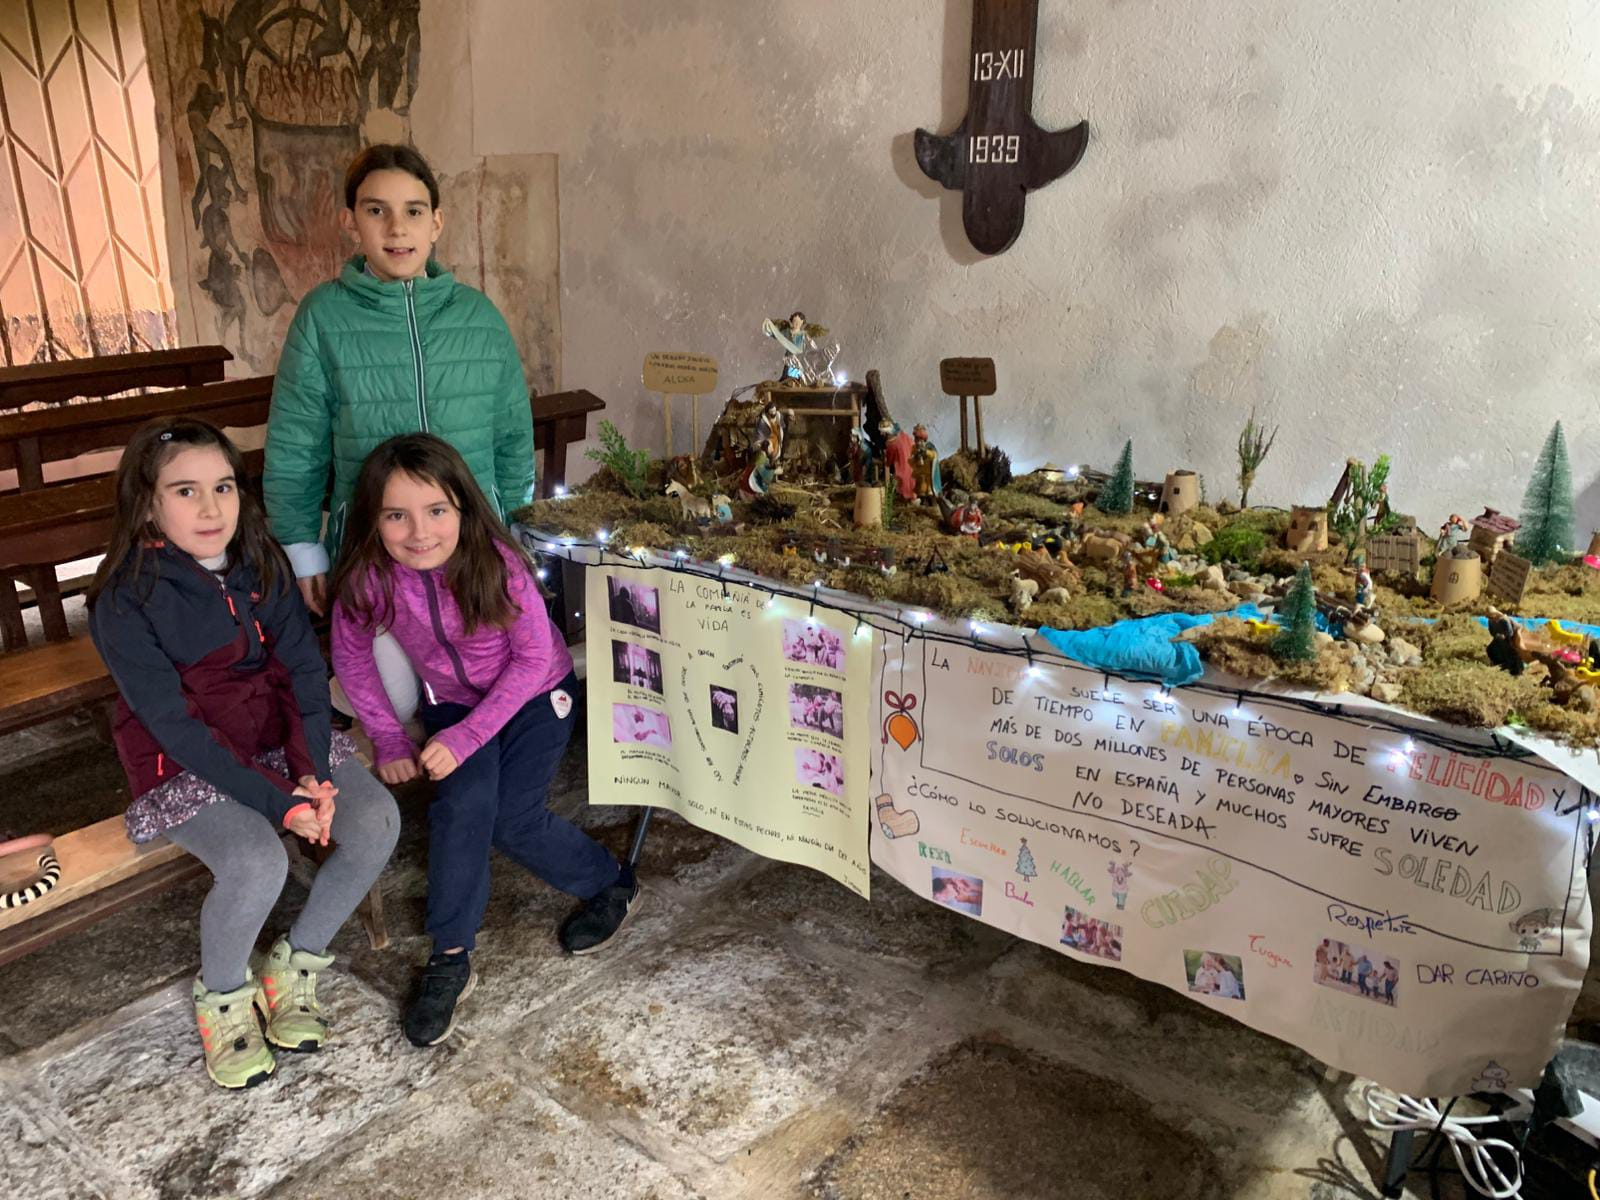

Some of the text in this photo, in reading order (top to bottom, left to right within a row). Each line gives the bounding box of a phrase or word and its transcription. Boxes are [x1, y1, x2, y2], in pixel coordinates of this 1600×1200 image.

[974, 49, 1024, 81] 13-XII
[969, 134, 1020, 163] 1939
[669, 577, 685, 594] LA
[685, 600, 696, 609] LA
[740, 609, 751, 620] ES
[931, 647, 950, 671] LA
[1069, 686, 1125, 705] SUELE
[1143, 698, 1177, 715] SER
[1192, 708, 1230, 729] UNA
[1247, 714, 1314, 748] ÉPOCA
[1333, 740, 1368, 766] DE
[1552, 788, 1566, 811] Y
[992, 686, 1014, 706] DE
[1034, 695, 1094, 723] TIEMPO
[1115, 714, 1145, 733] EN
[1362, 784, 1462, 821] EMBARGO
[990, 715, 1018, 735] MÁS
[1025, 724, 1042, 739] DE
[1055, 729, 1083, 747] DOS
[1180, 756, 1201, 777] DE
[1216, 768, 1297, 805] PERSONAS
[1307, 799, 1391, 835] MAYORES
[968, 801, 987, 816] LO
[1072, 790, 1104, 810] NO
[720, 811, 731, 822] EN
[986, 740, 1046, 773] SOLOS
[1075, 765, 1101, 783] EN
[1114, 770, 1181, 804] ESPAÑA
[1216, 798, 1288, 829] MUCHOS
[1307, 827, 1364, 857] SUFRE
[1373, 847, 1523, 915] SOLEDAD
[1050, 859, 1097, 907] HABLAR
[1416, 964, 1540, 989] DAR CARIÑO
